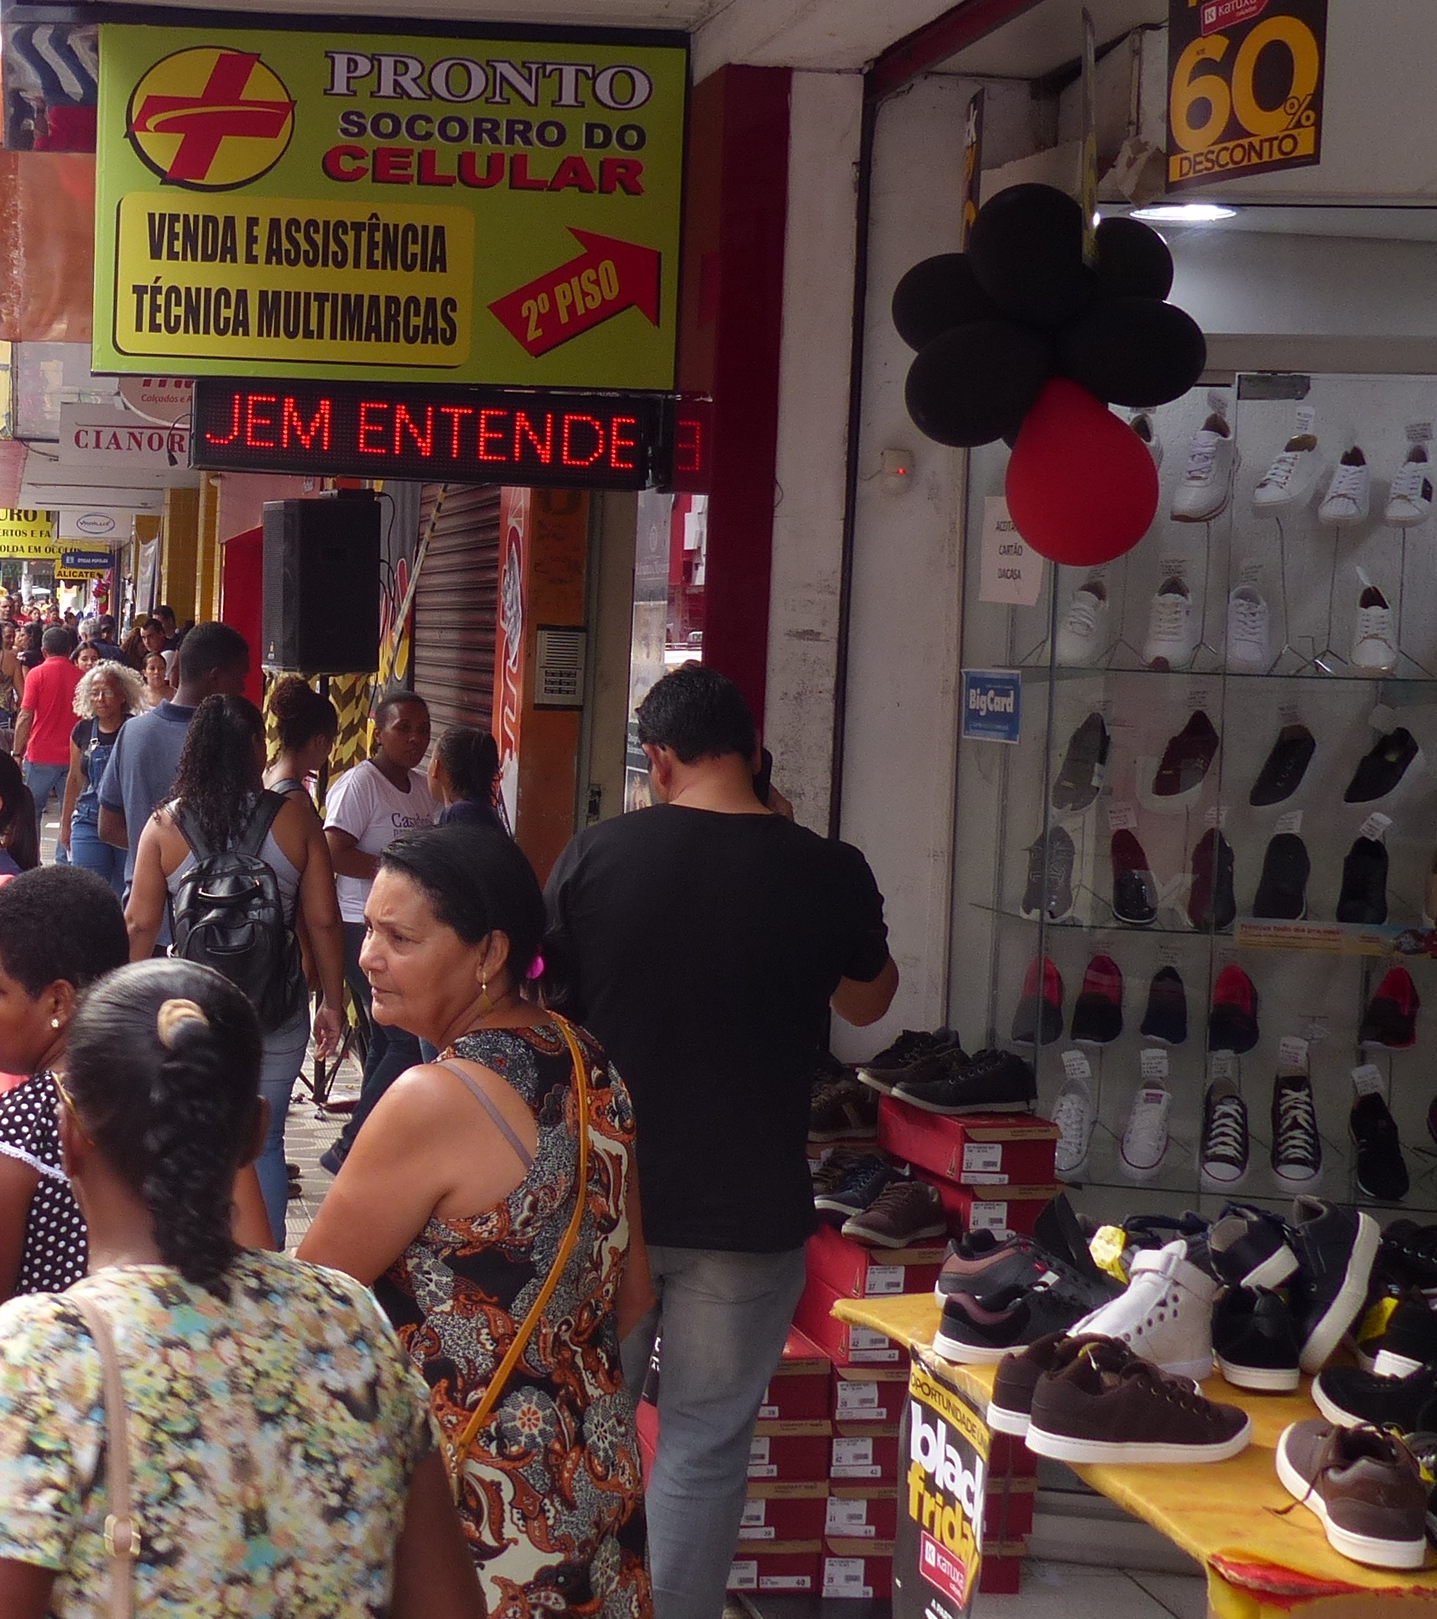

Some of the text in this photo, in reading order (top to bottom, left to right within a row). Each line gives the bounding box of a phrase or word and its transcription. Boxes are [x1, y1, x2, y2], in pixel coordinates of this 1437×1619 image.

[324, 51, 653, 111] PRONTO
[1170, 15, 1319, 152] 60%
[339, 110, 647, 151] SOCORRO DO
[1179, 133, 1299, 178] DESCONTO
[322, 145, 645, 196] CELULAR
[147, 212, 448, 274] VENDA E ASSISTÊNCIA
[132, 275, 458, 346] TÉCNICA MULTIMARCAS
[521, 259, 619, 342] 2º PISO
[141, 393, 178, 404] Calçados
[74, 429, 186, 453] CIANOR
[359, 402, 636, 469] ENTENDE
[30, 529, 36, 537] E
[996, 521, 1017, 532] ACEITA
[28, 545, 42, 554] EM
[998, 542, 1023, 556] CARTÃO
[56, 571, 96, 579] ALICATE
[997, 568, 1022, 580] DACASA
[969, 688, 1015, 716] BigCard
[851, 1340, 859, 1348] 42
[910, 1373, 977, 1440] OPORTUNIDADE
[795, 1578, 806, 1586] 40
